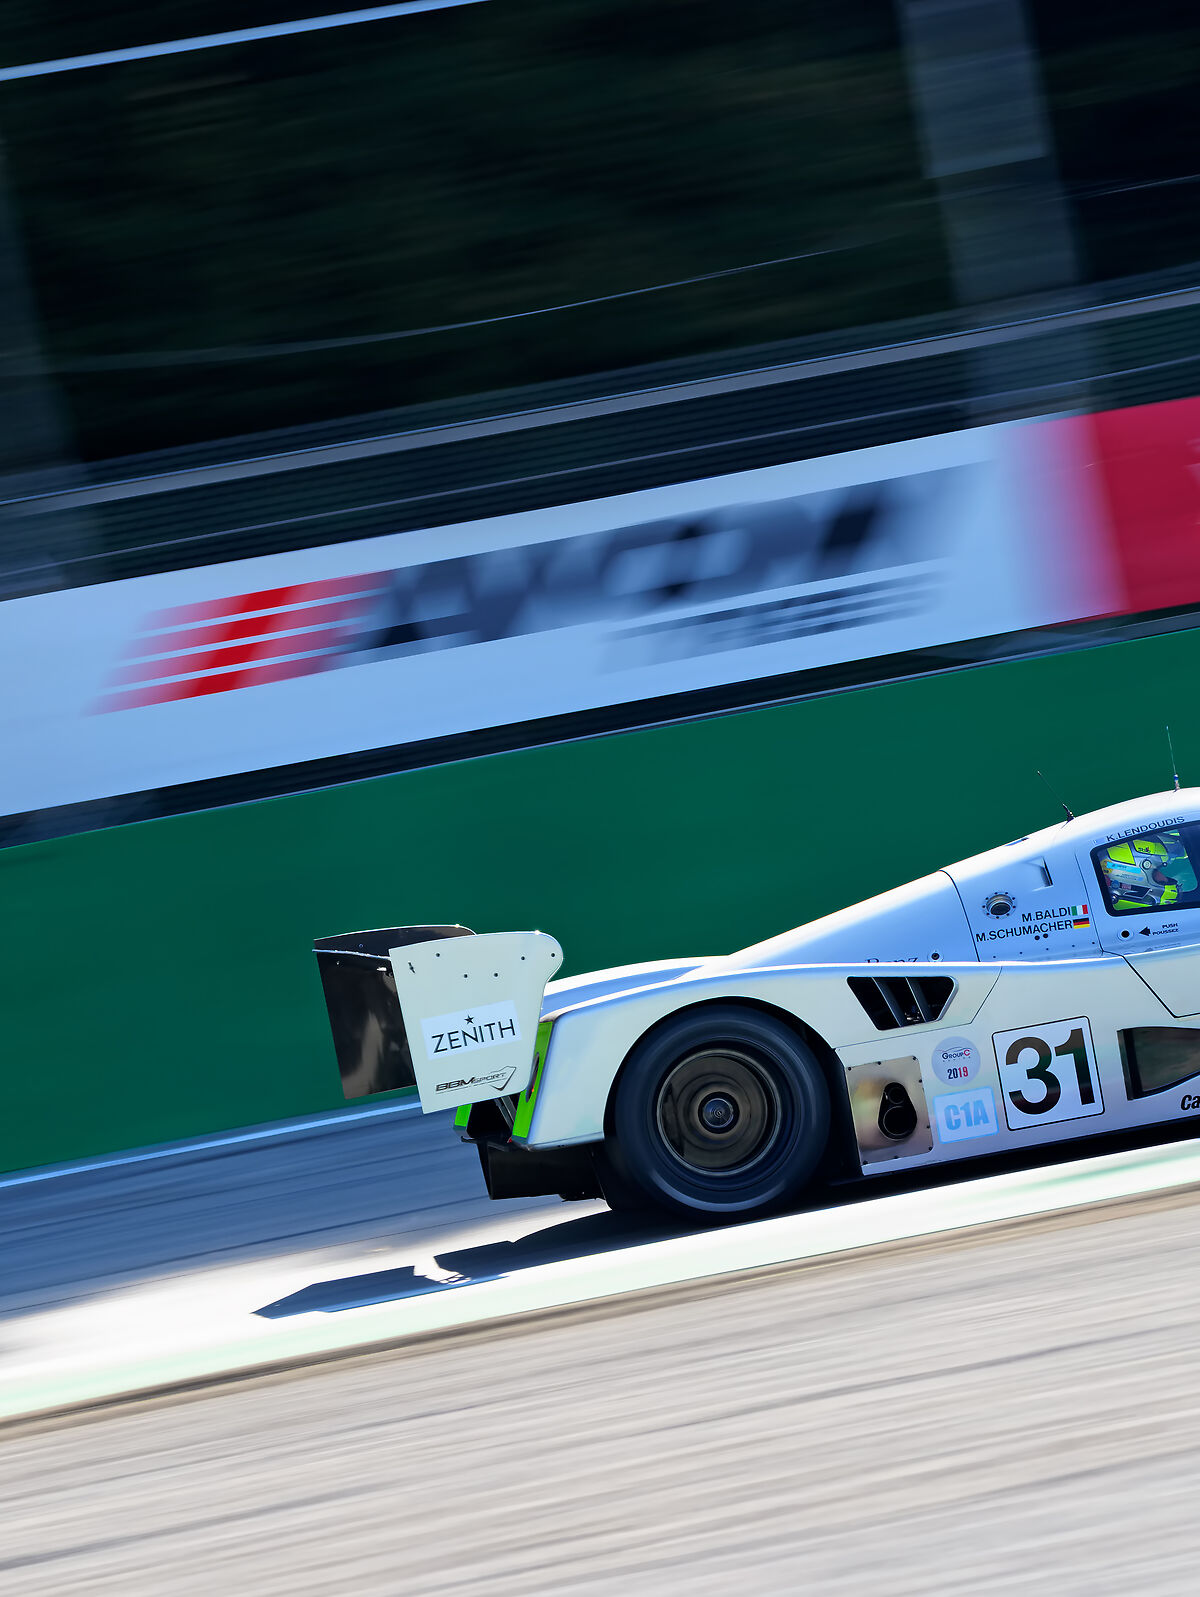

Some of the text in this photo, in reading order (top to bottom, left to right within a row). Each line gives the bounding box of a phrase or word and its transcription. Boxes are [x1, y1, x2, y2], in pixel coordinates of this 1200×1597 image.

[1107, 816, 1185, 842] K.LENDOUDIS
[1022, 907, 1071, 922] M.BALDI
[976, 920, 1072, 942] M.SCHUMACHER
[431, 1018, 516, 1053] ZENITH
[947, 1066, 969, 1080] 2019
[1005, 1028, 1095, 1115] 31
[944, 1099, 990, 1131] C1A
